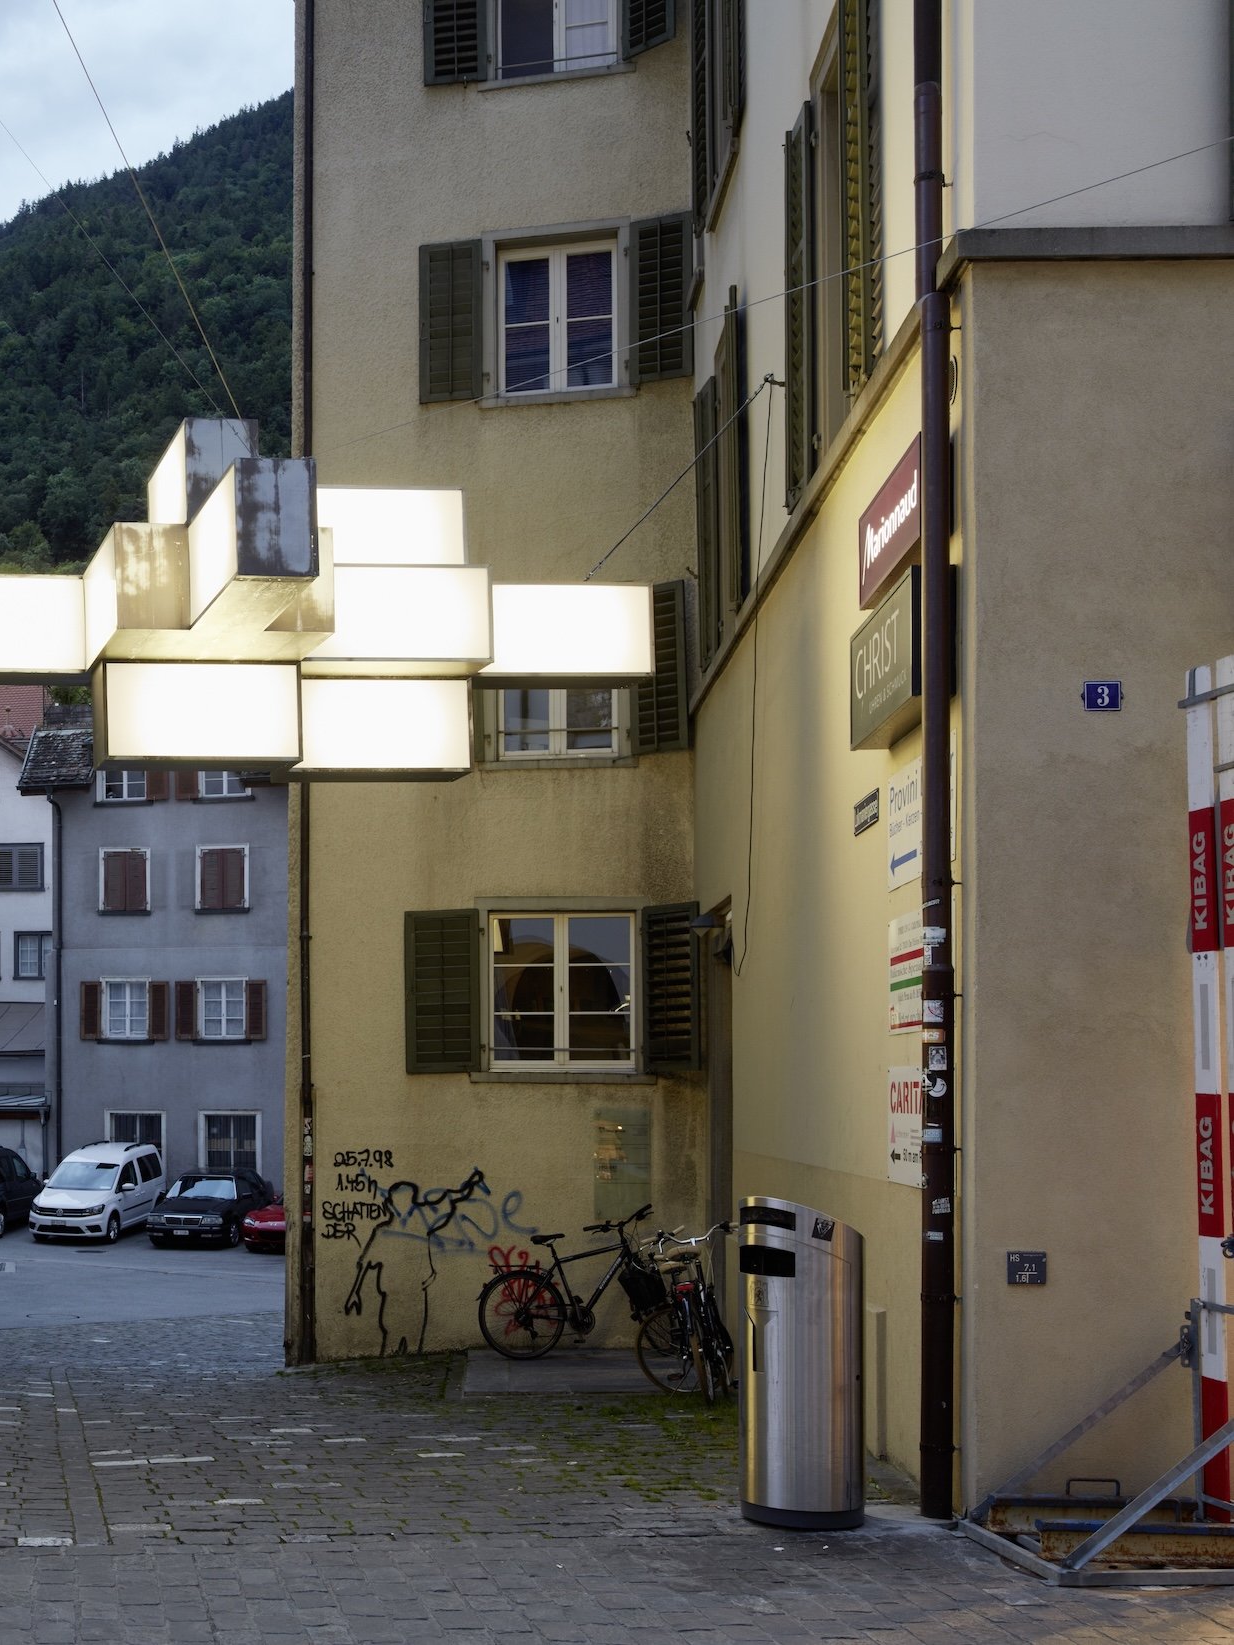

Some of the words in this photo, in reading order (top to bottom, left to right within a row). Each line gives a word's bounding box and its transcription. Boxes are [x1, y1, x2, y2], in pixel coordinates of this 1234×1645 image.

[861, 468, 918, 586] Marionnaud
[855, 607, 900, 699] CHRIST
[1097, 685, 1110, 707] 3
[889, 769, 918, 816] Provini
[1192, 831, 1208, 930] KIBAG
[333, 1148, 394, 1169] 25.7.98
[1198, 1116, 1214, 1215] KIBAG
[321, 1200, 388, 1223] SCHATTEN
[321, 1222, 362, 1249] DER
[1010, 1254, 1020, 1262] HS
